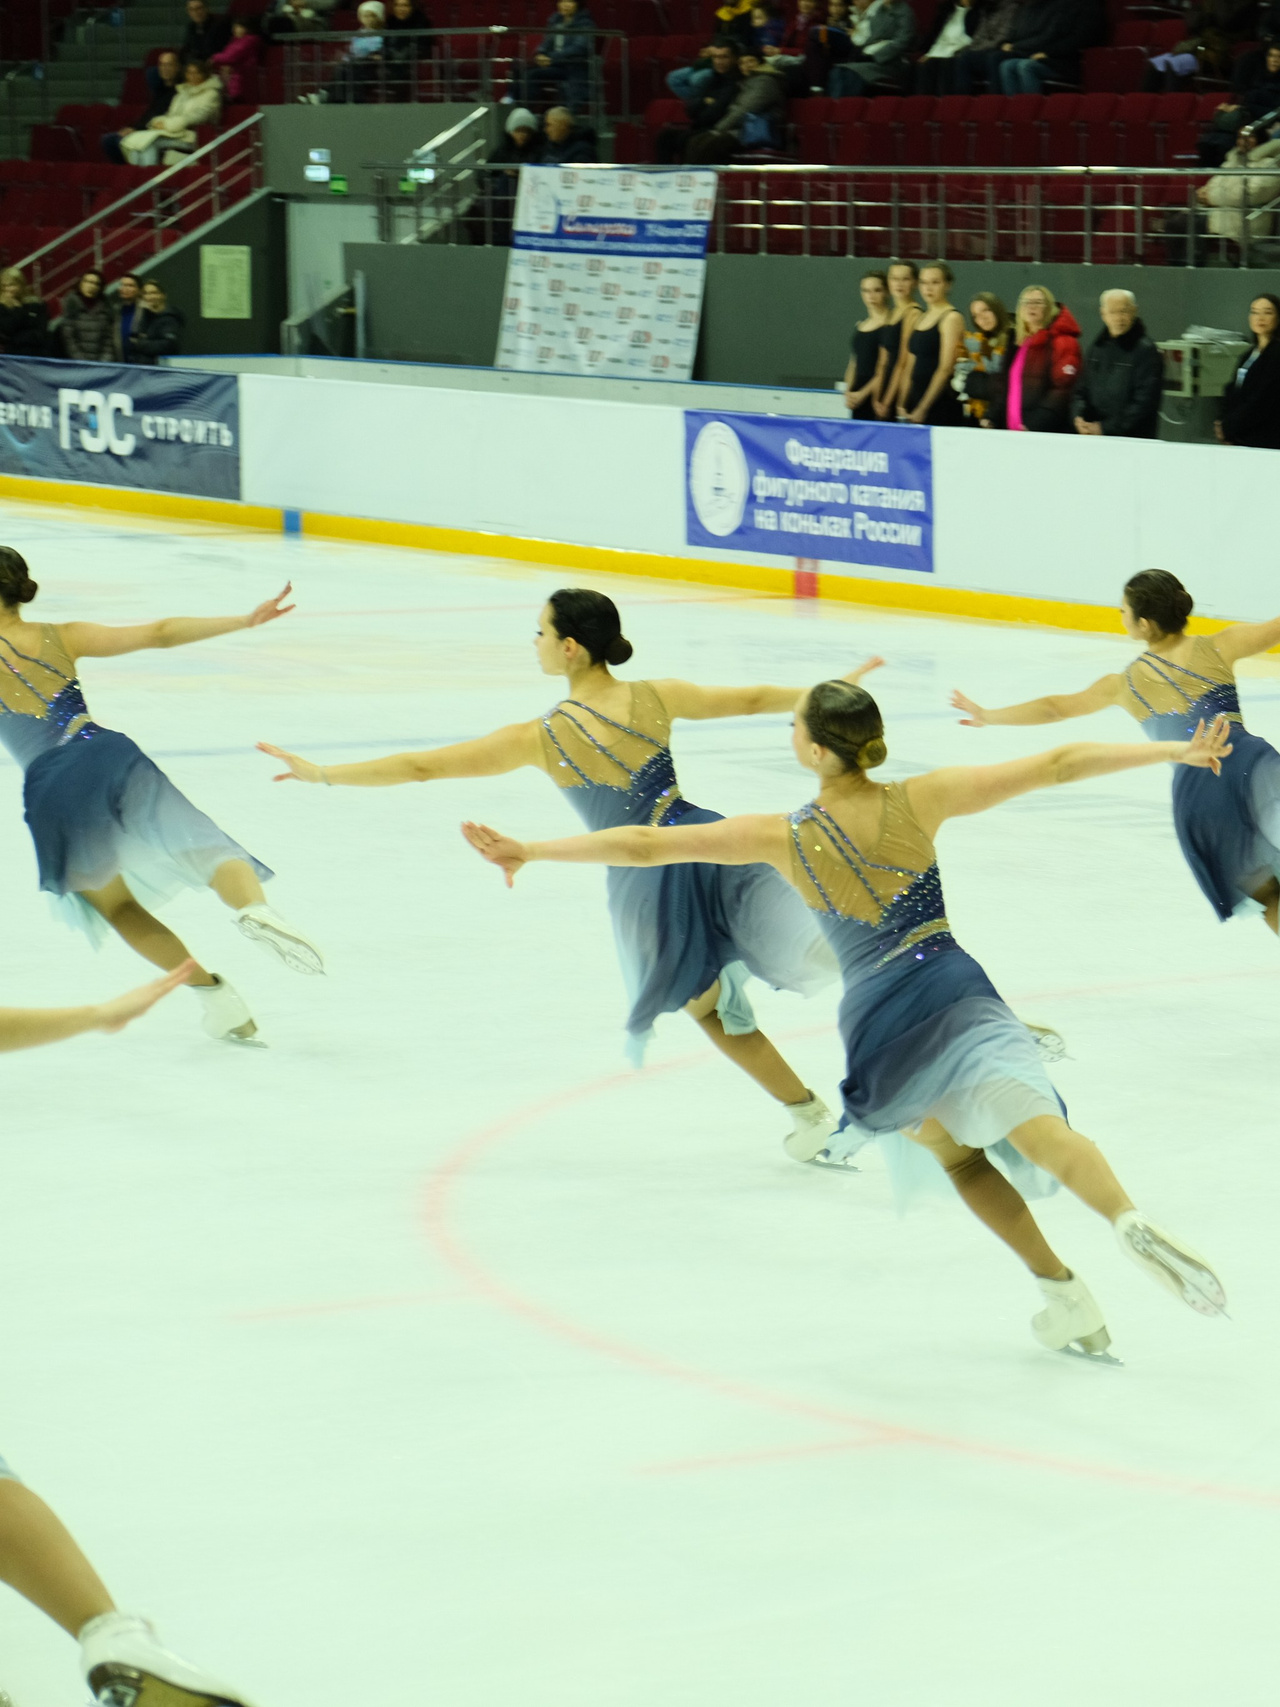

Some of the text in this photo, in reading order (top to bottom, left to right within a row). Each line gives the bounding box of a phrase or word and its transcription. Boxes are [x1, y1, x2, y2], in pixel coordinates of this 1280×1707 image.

[58, 387, 136, 456] ГЭС
[141, 415, 234, 447] СТРОИТЬ
[785, 438, 889, 476] Федерация
[752, 468, 926, 512] фигурного катания
[754, 508, 922, 546] на коньках России
